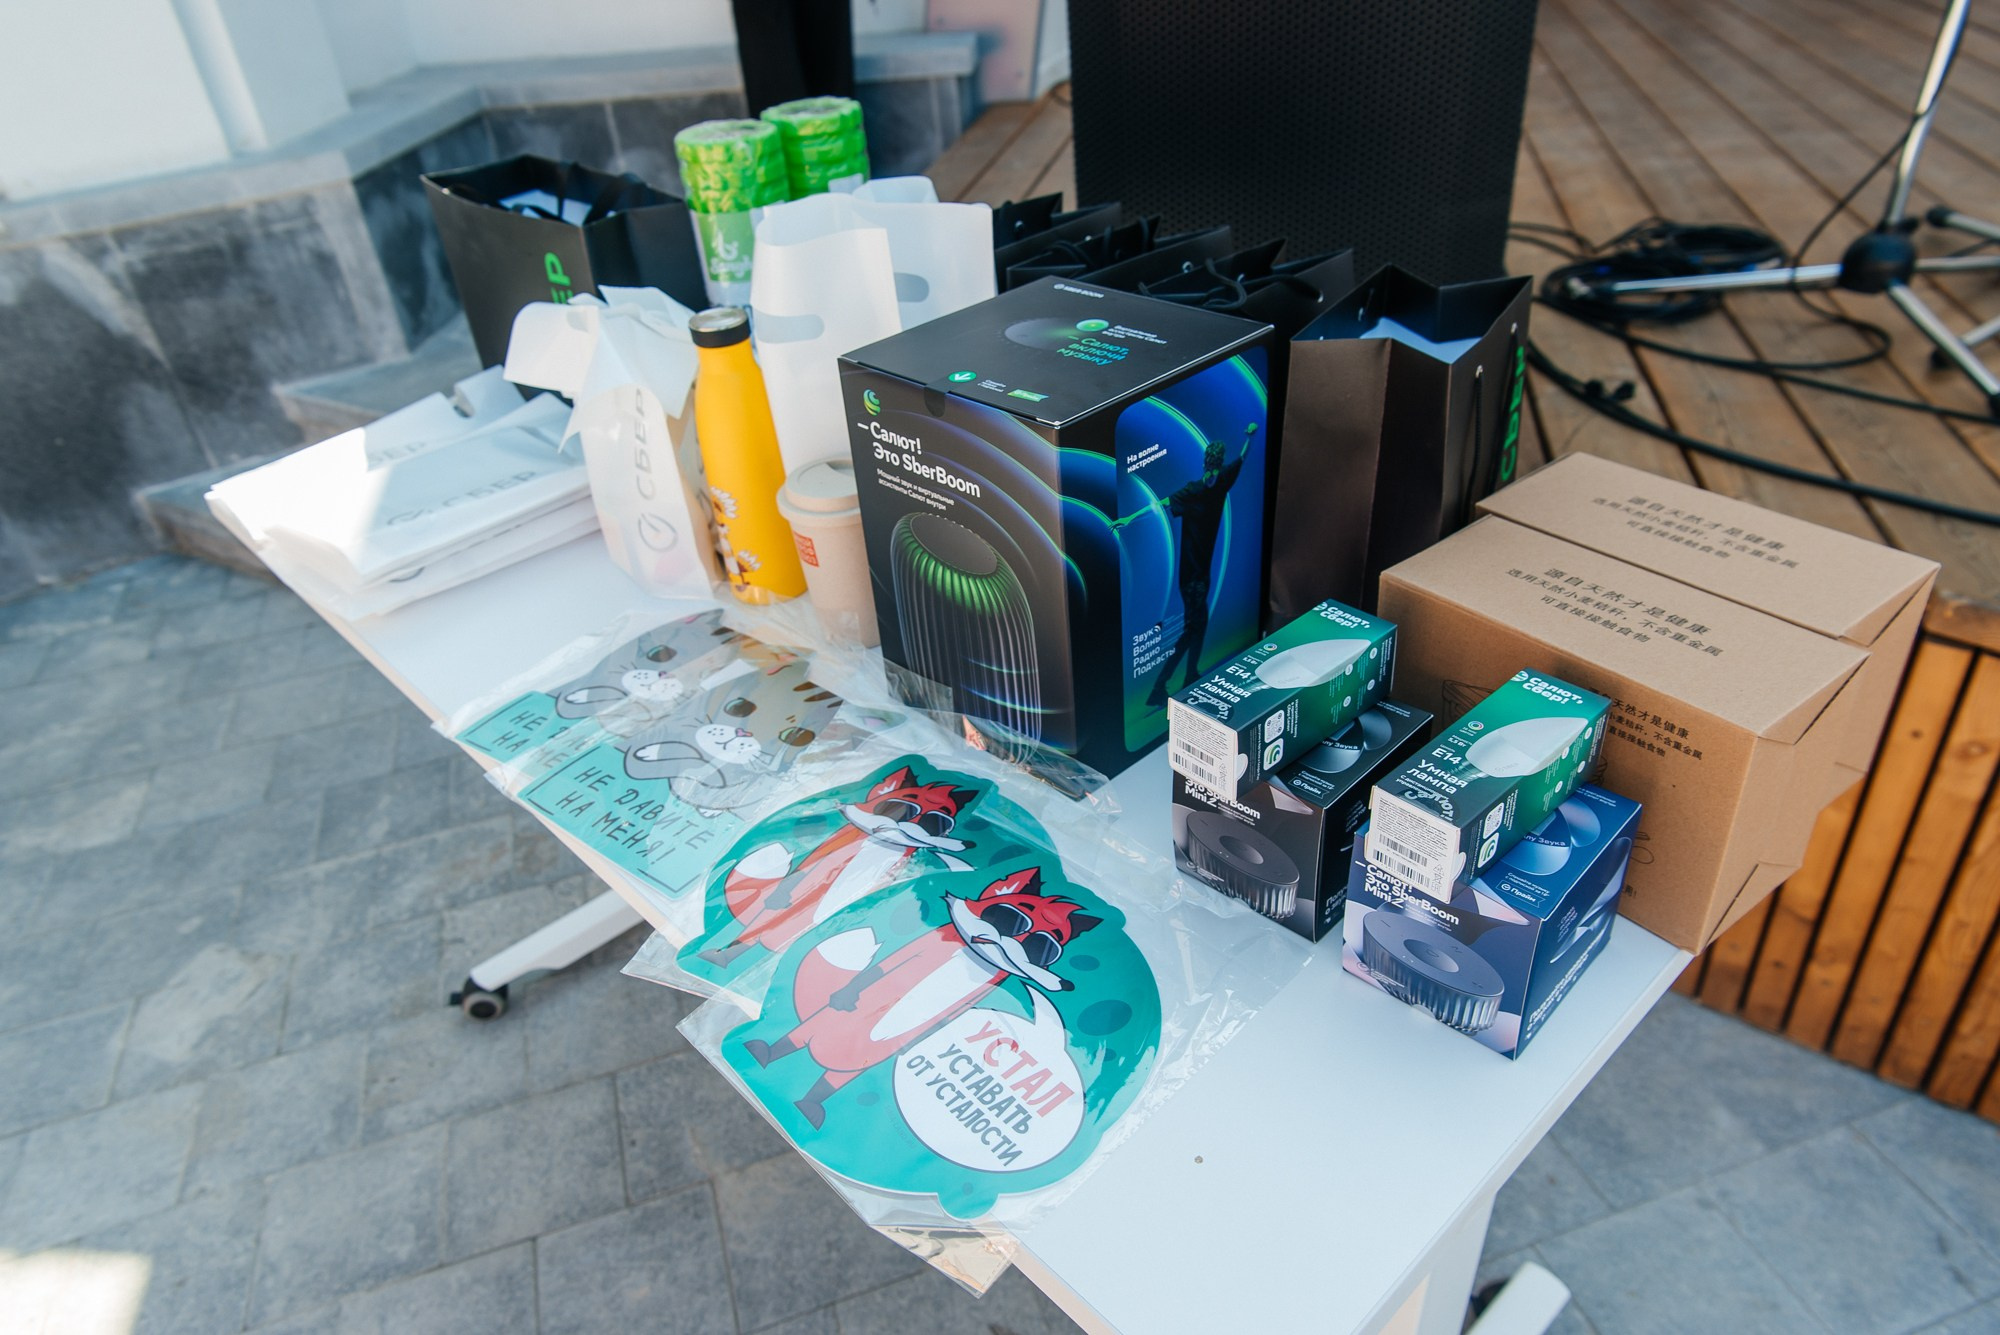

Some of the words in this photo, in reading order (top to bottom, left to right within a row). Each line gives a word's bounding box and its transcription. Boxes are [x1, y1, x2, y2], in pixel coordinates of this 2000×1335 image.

[870, 421, 922, 455] Салют!
[1127, 454, 1138, 464] На
[1138, 443, 1159, 459] волне
[1127, 448, 1167, 473] настроения
[873, 442, 900, 466] Это
[902, 453, 981, 498] SberBoom
[1544, 568, 1712, 635] 源自天然才是健康
[1320, 611, 1359, 629] Сбер!
[1327, 606, 1370, 629] Салют,
[1540, 595, 1651, 643] 可直接接触食物
[1132, 627, 1154, 646] Звук
[1133, 634, 1162, 657] Волны
[1133, 646, 1160, 668] Радио
[1133, 647, 1176, 679] Подкасты
[1225, 665, 1251, 679] E14
[1200, 682, 1241, 703] лампа
[1211, 674, 1252, 698] Умная
[1522, 682, 1570, 705] Сбер!
[1529, 677, 1583, 705] Салют,
[509, 710, 548, 731] НЕ
[1590, 687, 1690, 739] 天然才是健康
[492, 730, 530, 752] НА
[1334, 742, 1358, 750] Звука
[1431, 747, 1462, 765] E14
[573, 766, 615, 792] НЕ
[1406, 768, 1457, 794] лампа
[1417, 759, 1469, 788] Умная
[1184, 784, 1208, 803] Mini
[1207, 797, 1218, 808] 2
[555, 790, 596, 818] НА
[591, 811, 676, 865] МЕНЯ!
[1538, 837, 1566, 846] Звука
[1366, 864, 1413, 893] Салют!
[1364, 883, 1392, 903] Mini
[1392, 898, 1405, 909] 2
[1365, 873, 1389, 891] Это
[1391, 888, 1459, 925] SberBoom
[1510, 887, 1536, 902] Прайм
[964, 1020, 1075, 1118] УСТАЛ
[937, 1043, 1033, 1135] УСТАВАТЬ
[906, 1054, 935, 1077] ОТ
[926, 1073, 1023, 1167] УСТАЛОСТИ
